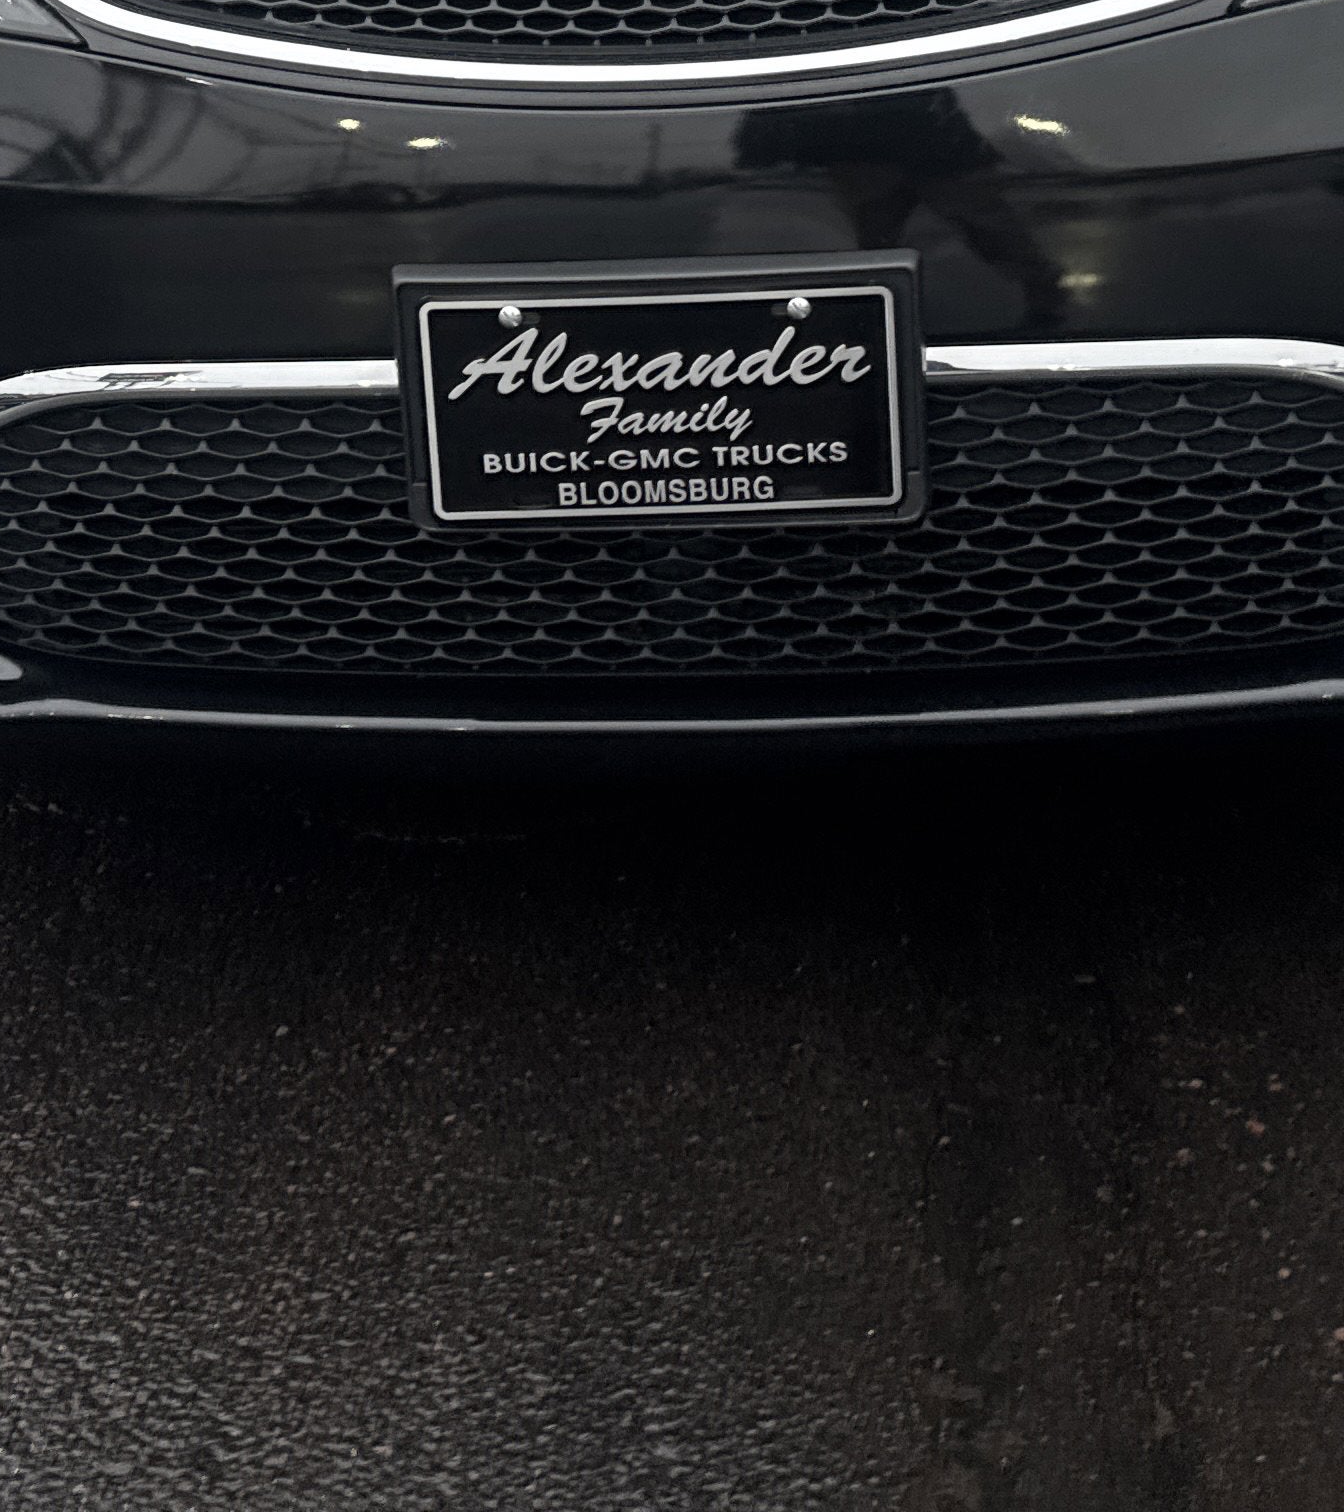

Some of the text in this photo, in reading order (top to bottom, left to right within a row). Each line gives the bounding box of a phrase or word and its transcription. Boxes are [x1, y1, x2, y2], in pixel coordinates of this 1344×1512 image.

[448, 326, 872, 400] Alexander
[580, 395, 754, 444] Family
[482, 441, 849, 475] BUICK-GMC TRUCKS
[558, 475, 774, 507] BLOOMSBURG
